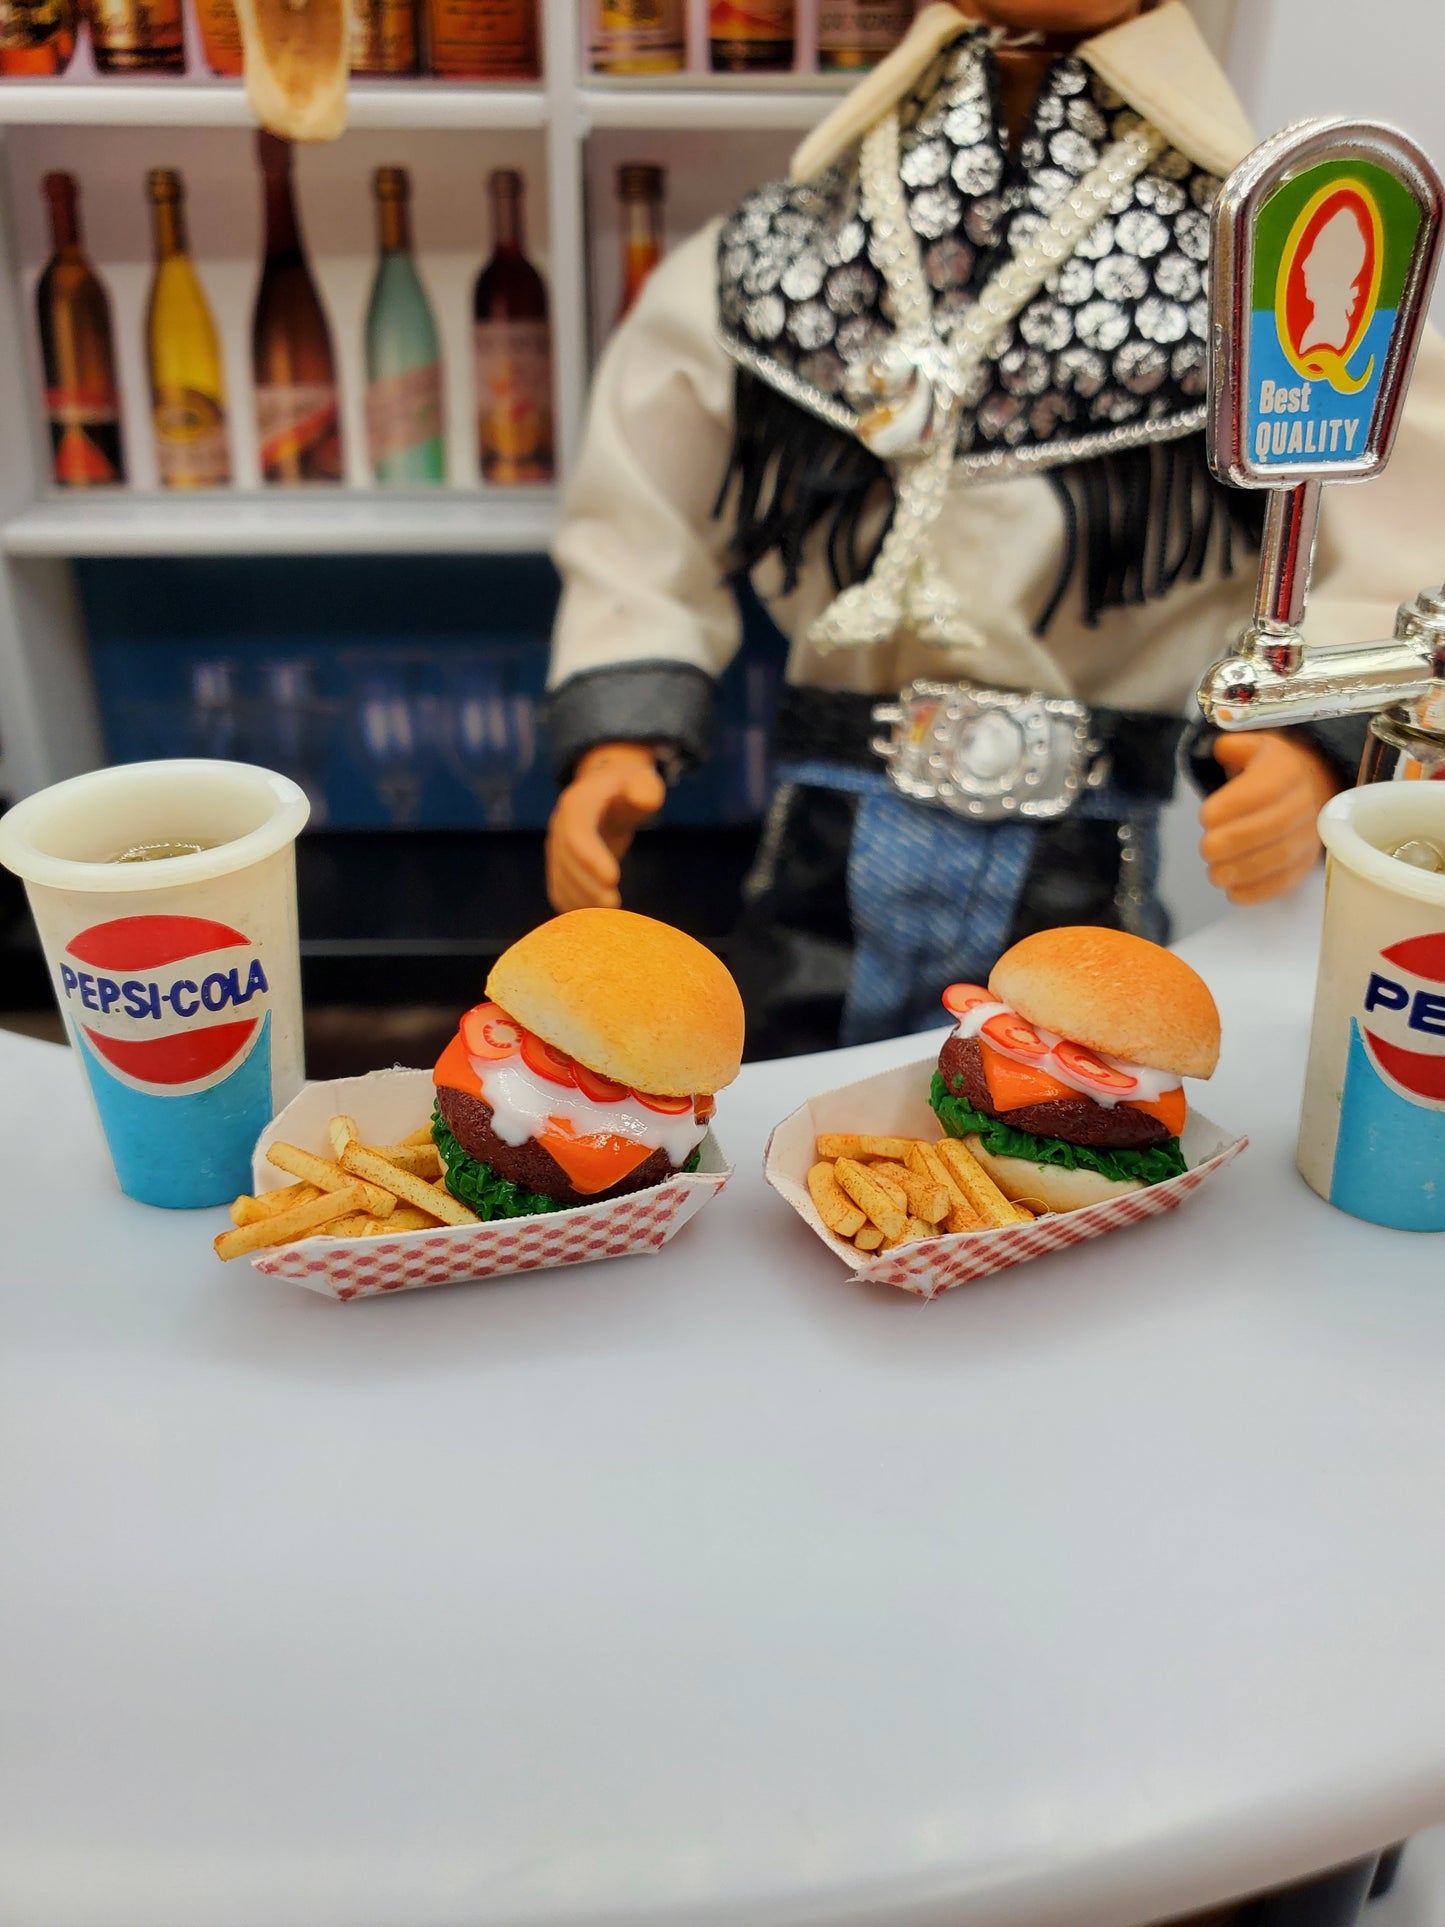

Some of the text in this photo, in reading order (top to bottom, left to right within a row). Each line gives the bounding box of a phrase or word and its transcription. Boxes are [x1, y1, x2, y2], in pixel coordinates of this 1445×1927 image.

[1258, 379, 1312, 414] Best
[1255, 418, 1360, 463] QUALITY
[59, 958, 269, 1020] PEPSI-COLA
